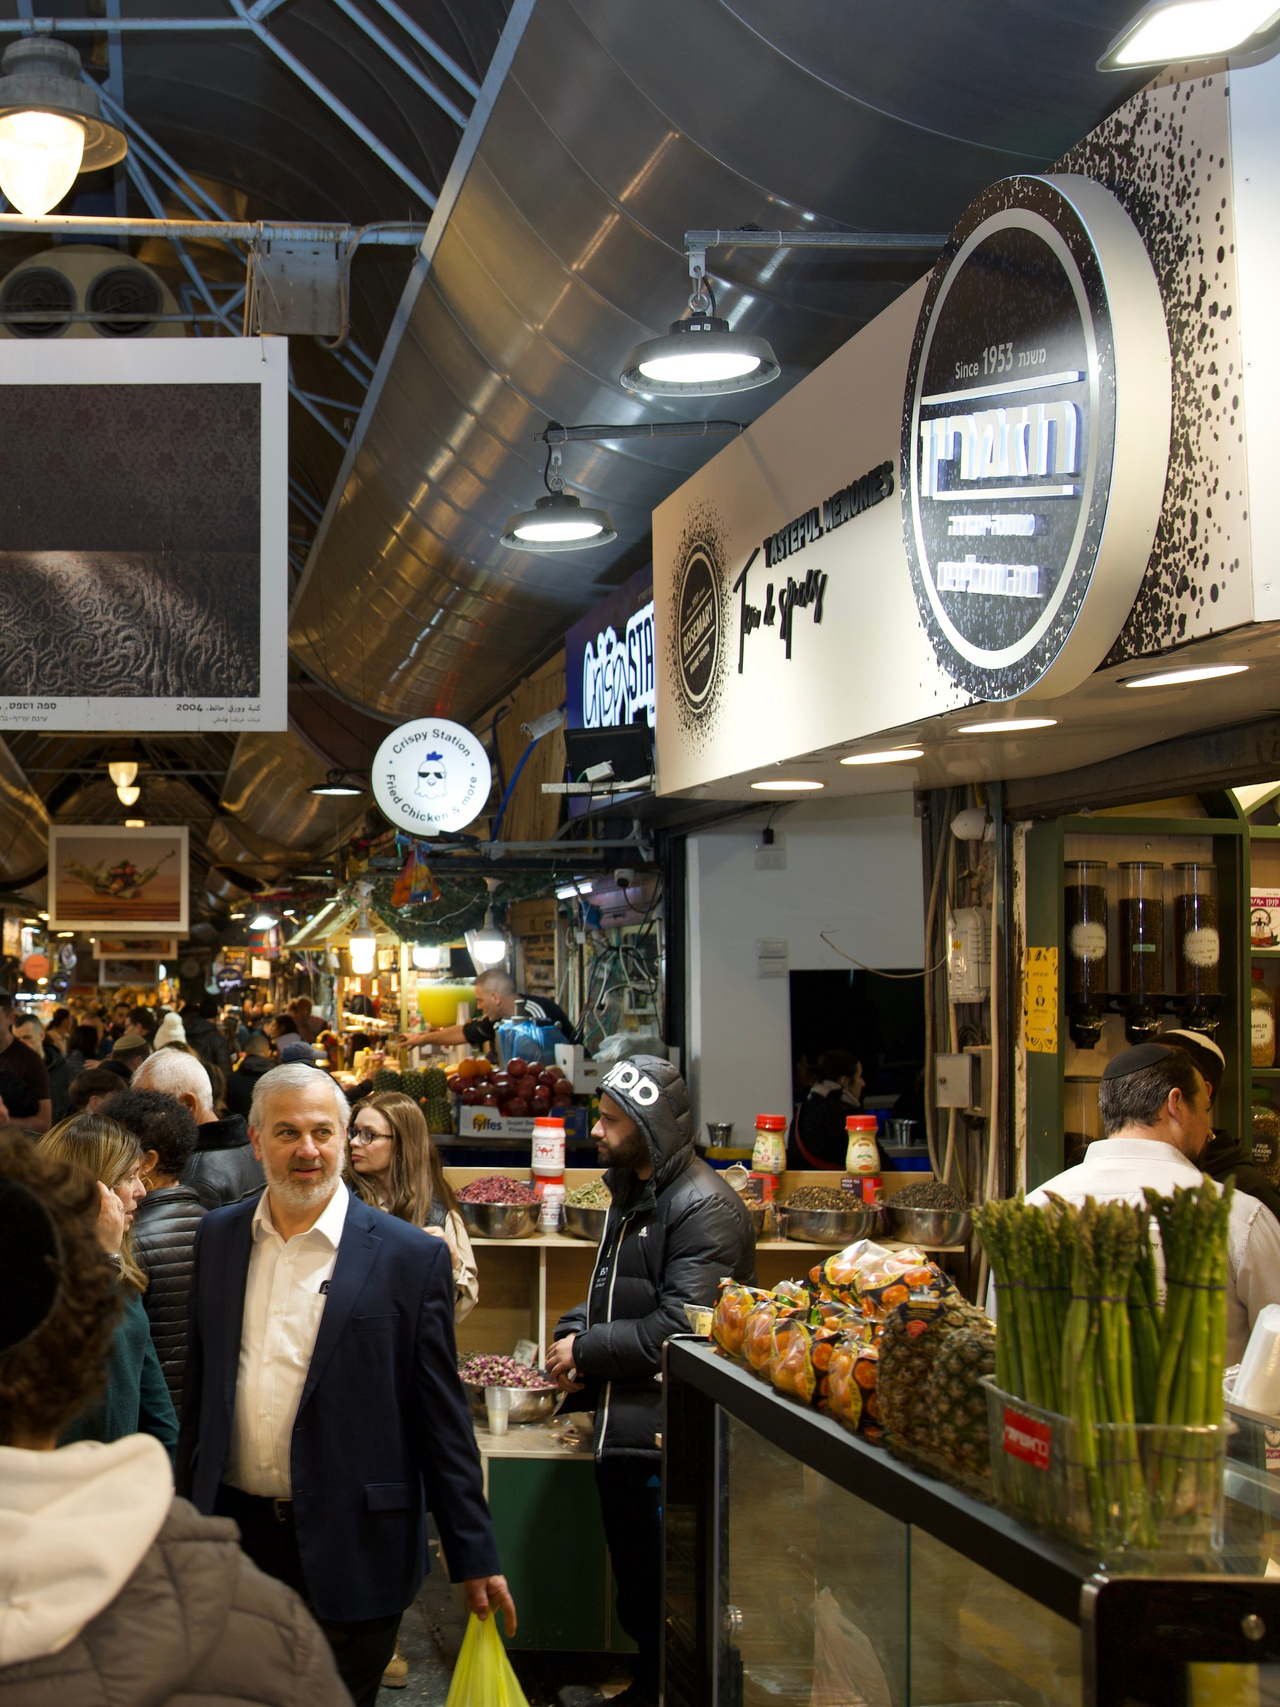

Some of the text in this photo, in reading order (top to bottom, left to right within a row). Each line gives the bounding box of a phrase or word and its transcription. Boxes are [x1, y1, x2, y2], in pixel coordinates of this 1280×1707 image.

[955, 342, 1013, 379] Since 1953
[1018, 348, 1046, 367] משנת
[763, 460, 894, 568] TASTEFUL MEMORIES
[683, 598, 713, 656] ROSEMARY
[628, 614, 654, 701] STA
[37, 702, 57, 710] ספה
[176, 704, 203, 712] 2004
[392, 728, 471, 757] Crispy Station
[386, 774, 403, 804] Fried
[401, 803, 449, 822] Chicken
[461, 776, 478, 806] more
[472, 1117, 502, 1132] fyffes
